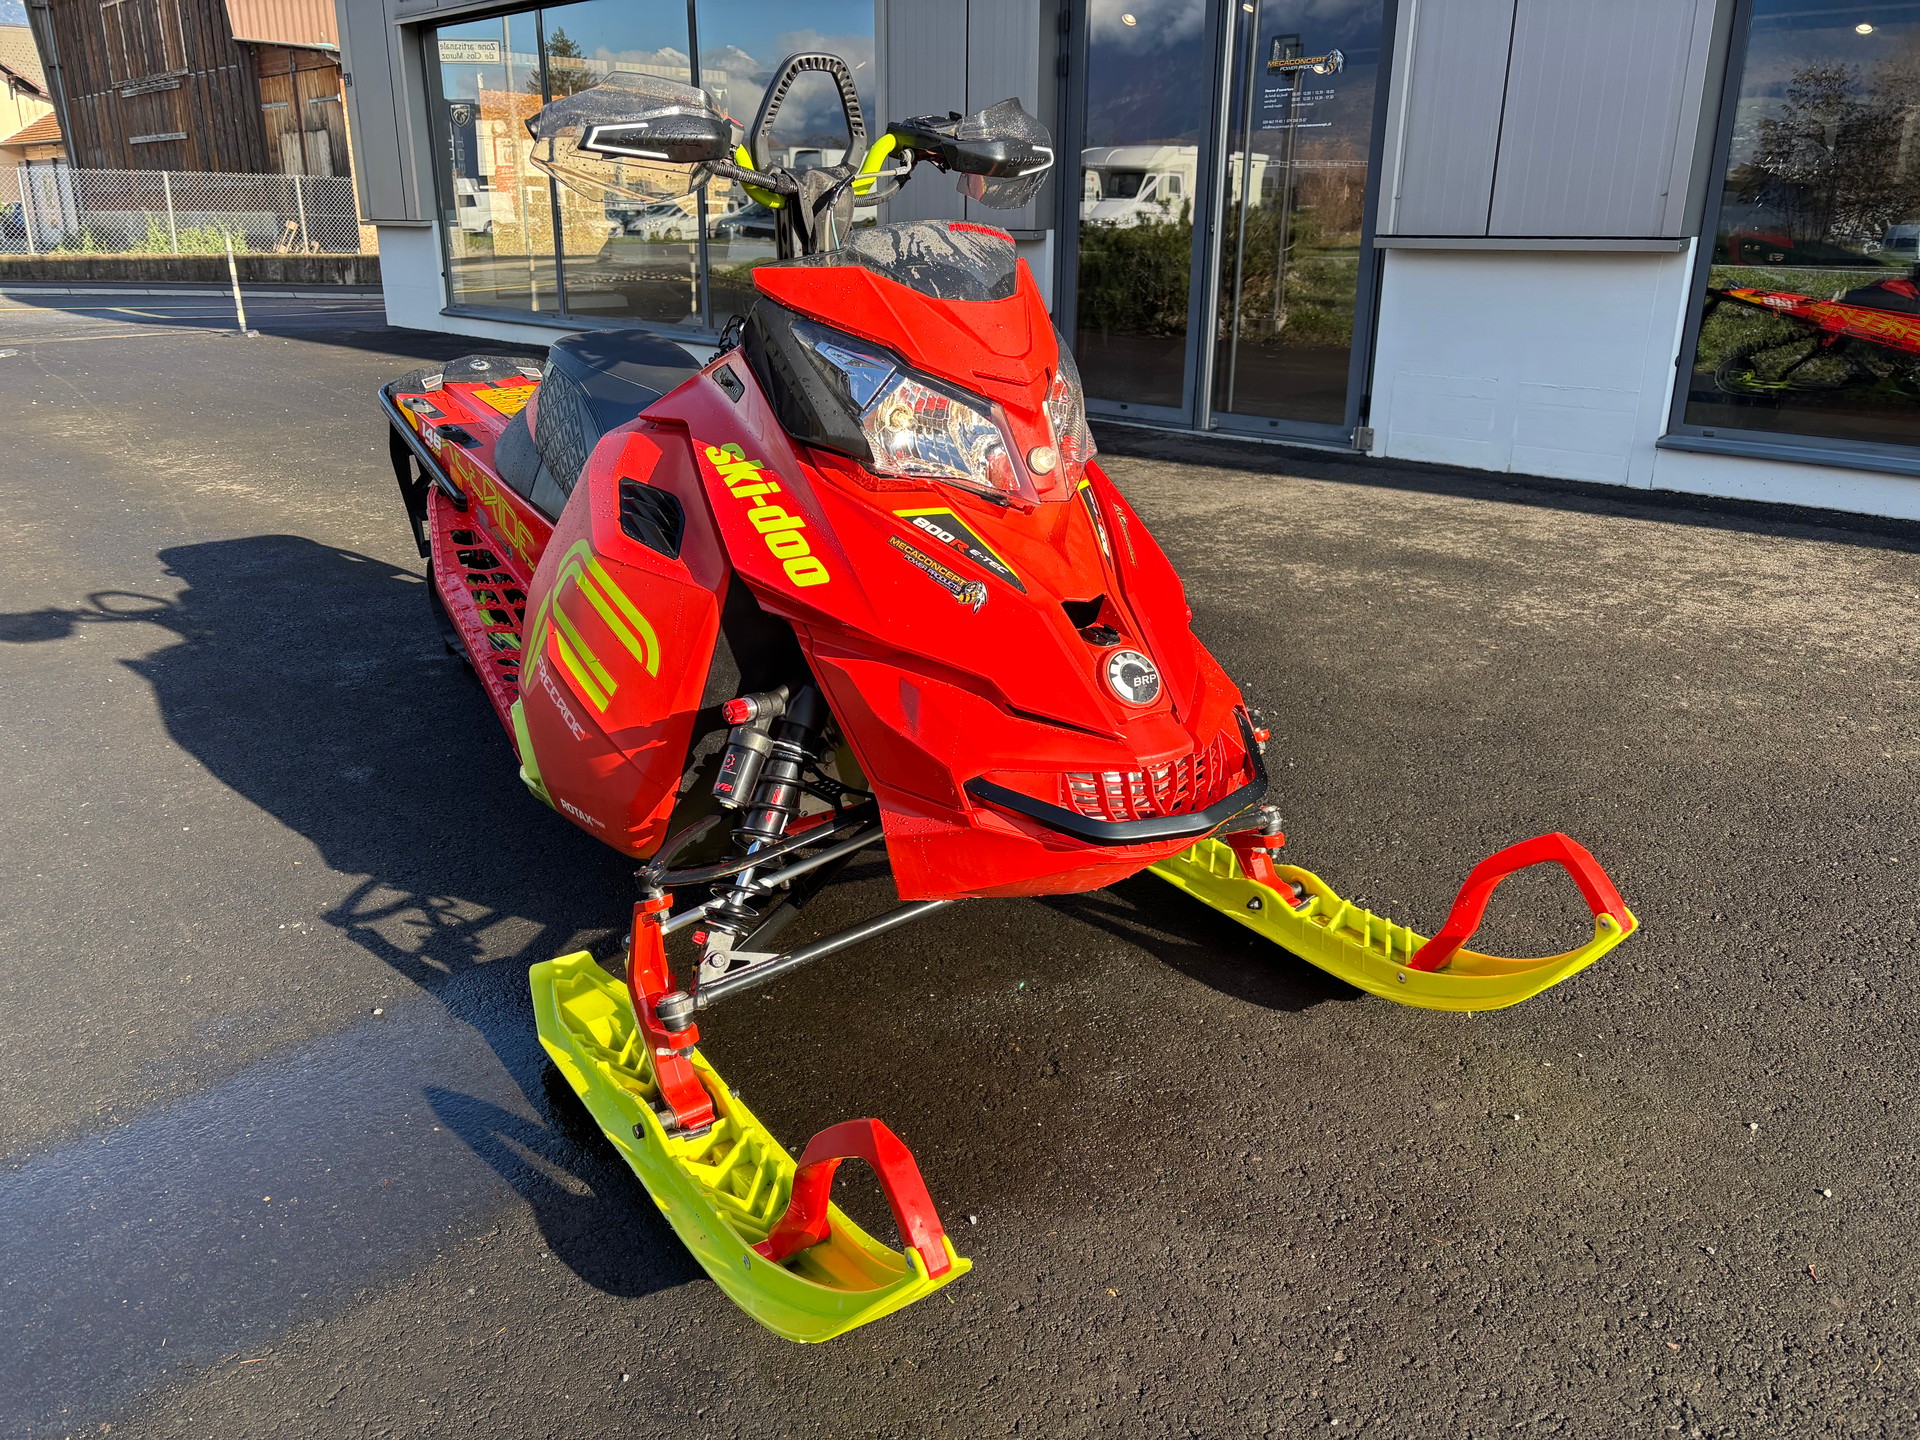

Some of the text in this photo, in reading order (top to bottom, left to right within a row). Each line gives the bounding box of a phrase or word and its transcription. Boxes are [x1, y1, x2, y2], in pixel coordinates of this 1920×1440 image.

[421, 422, 442, 450] 146
[705, 443, 830, 587] ski-doo
[889, 537, 967, 587] MECACONCEPT
[904, 554, 928, 571] POWER
[928, 568, 962, 592] PRODUCTS
[969, 549, 1009, 574] E-TEC
[536, 654, 584, 740] FREERIDE
[1133, 673, 1157, 688] BRP
[560, 798, 594, 826] ROTAX
